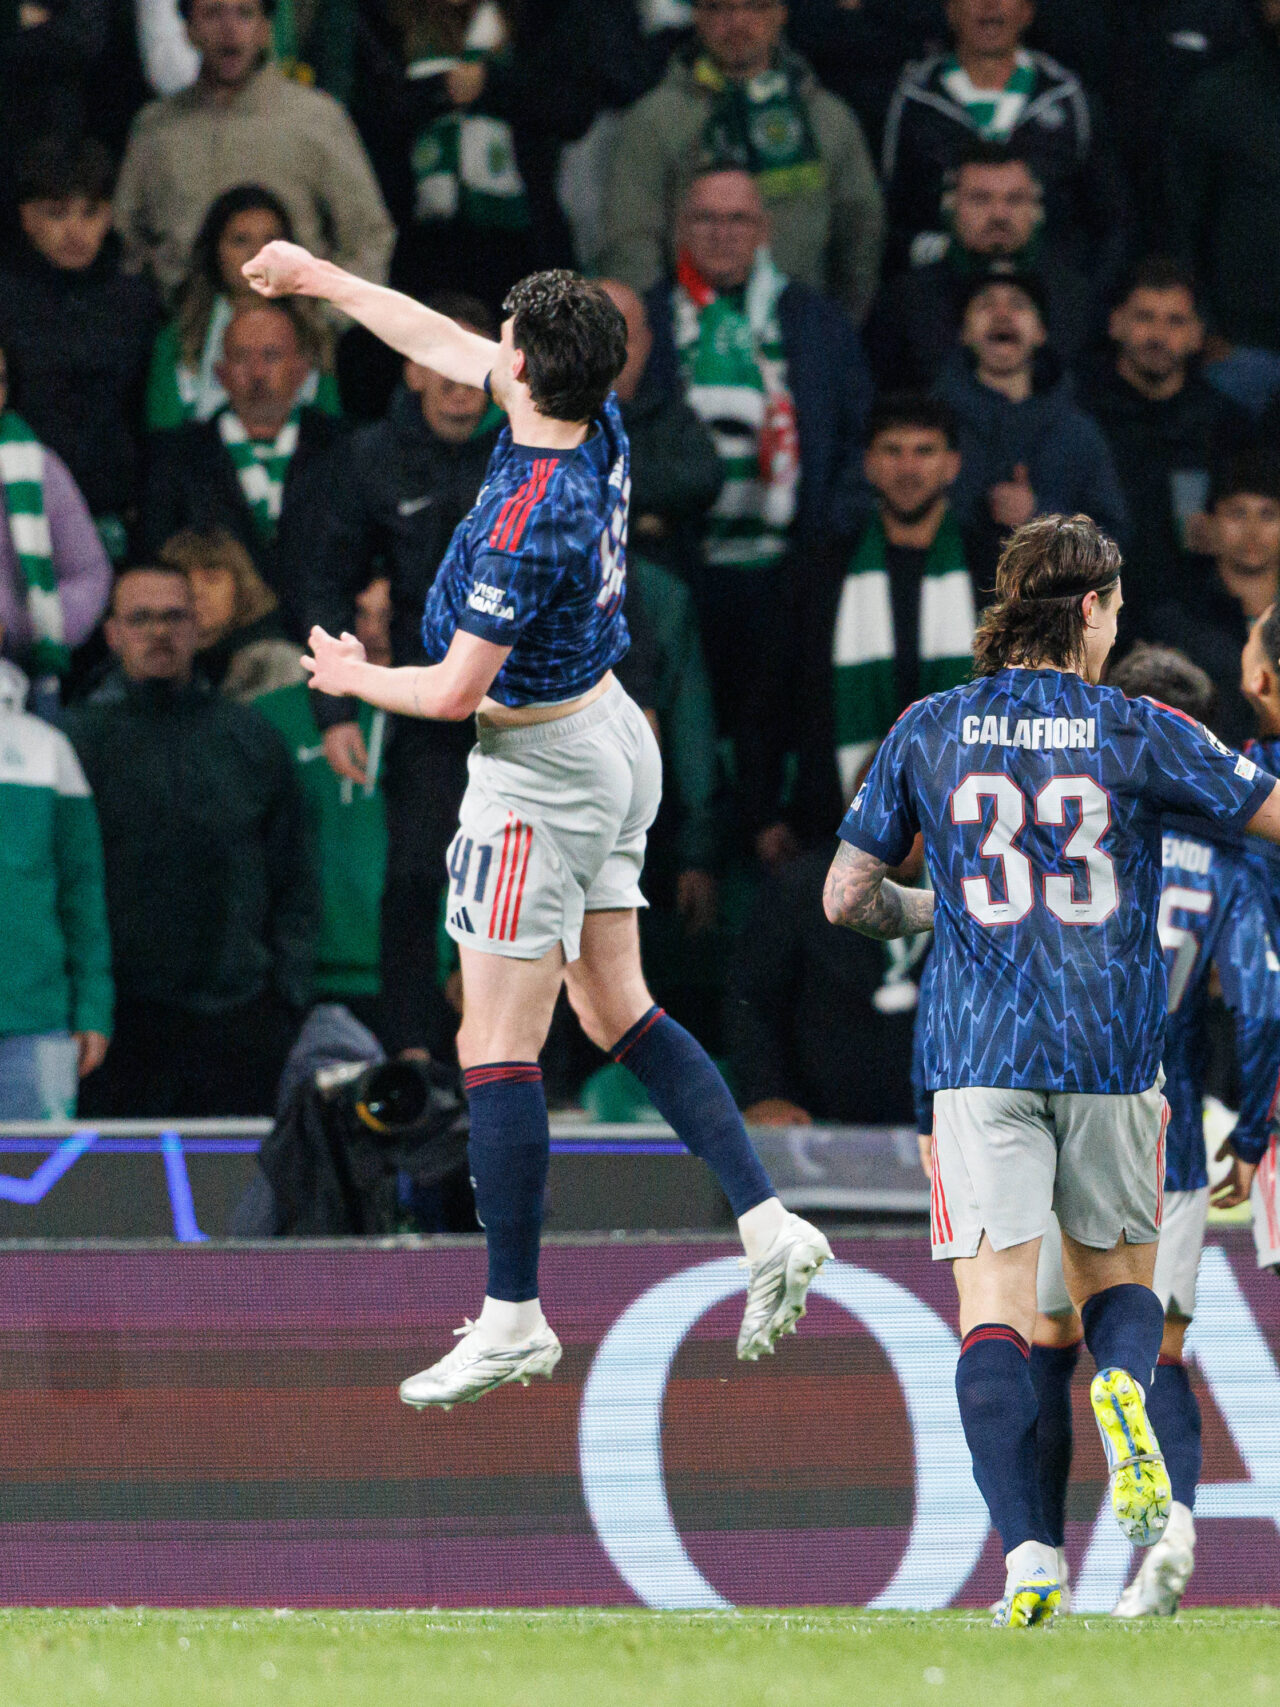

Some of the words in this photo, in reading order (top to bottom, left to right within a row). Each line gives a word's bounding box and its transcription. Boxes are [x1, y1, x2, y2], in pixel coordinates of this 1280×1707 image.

[473, 580, 506, 602] VISIT
[962, 715, 1096, 749] CALAFIORI
[449, 834, 493, 904] 41
[950, 772, 1120, 927] 33
[1161, 836, 1213, 875] ENDI
